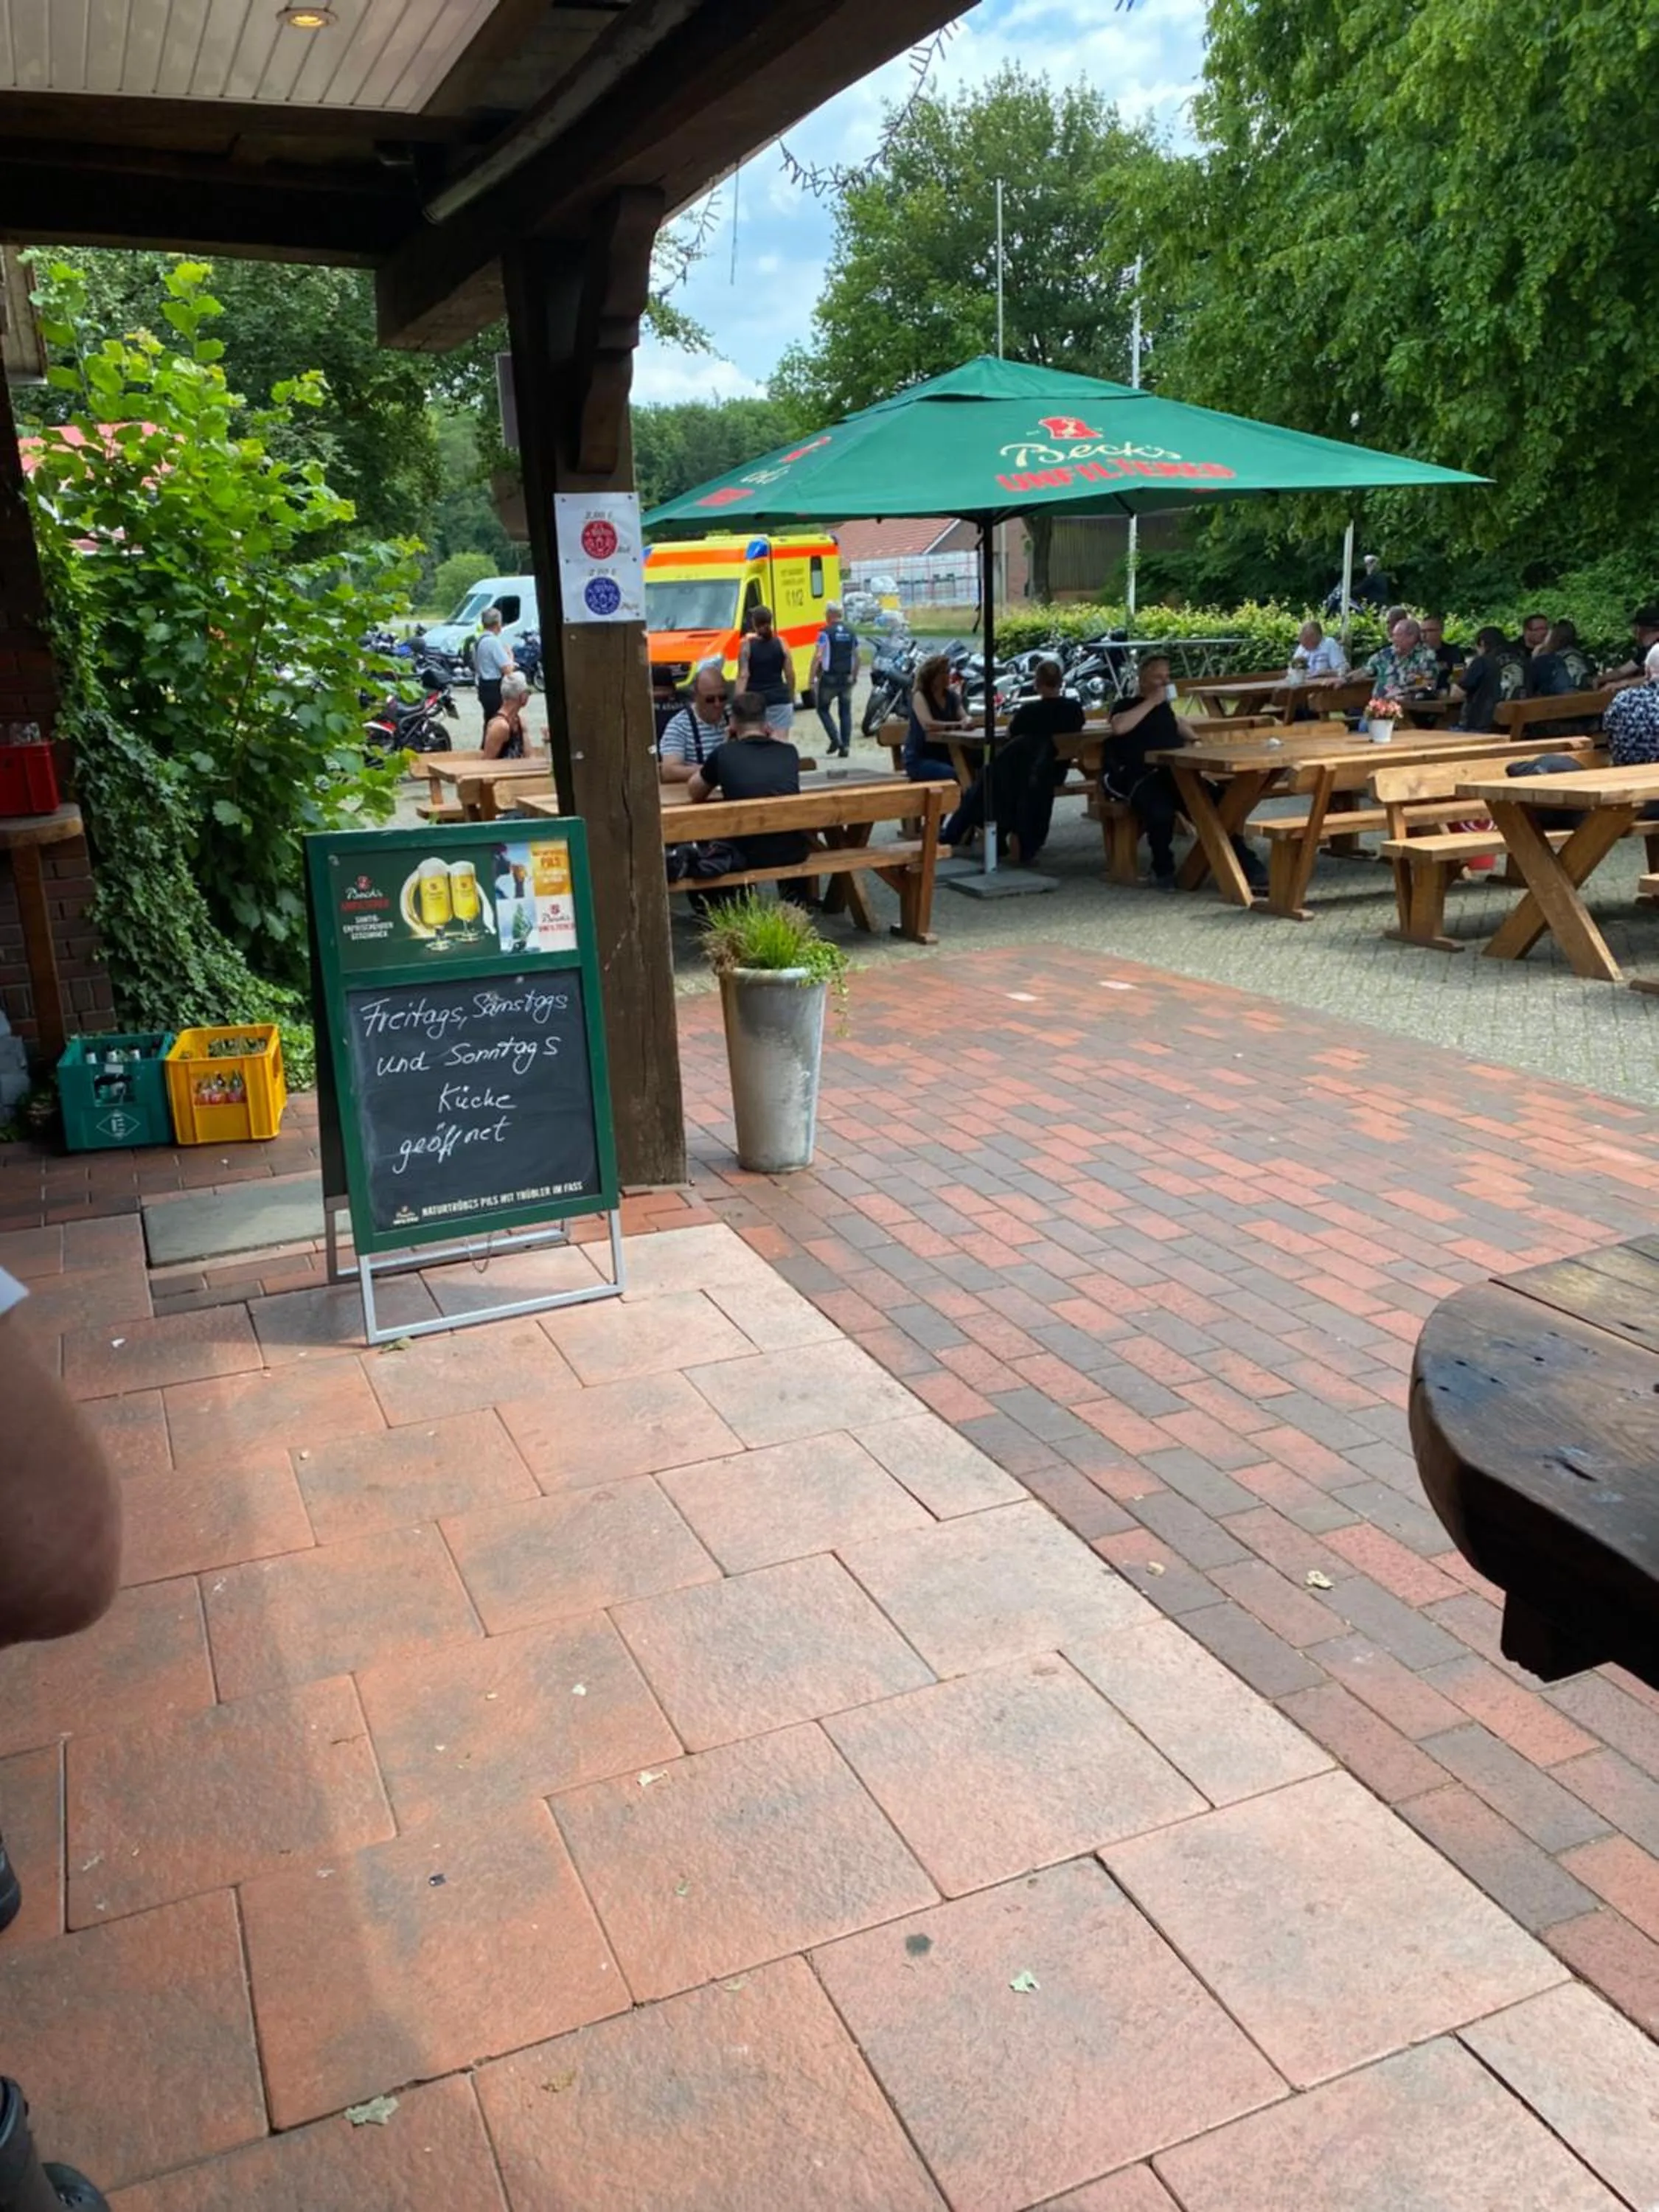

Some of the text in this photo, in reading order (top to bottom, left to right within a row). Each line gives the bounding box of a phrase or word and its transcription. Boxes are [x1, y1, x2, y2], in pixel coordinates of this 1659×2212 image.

[1000, 441, 1183, 467] Beck's
[995, 458, 1237, 492] UNFILTERED
[360, 998, 468, 1039] Freitags,
[377, 1051, 431, 1076] und
[438, 1082, 517, 1112] Küche
[392, 1116, 512, 1174] geöffnet
